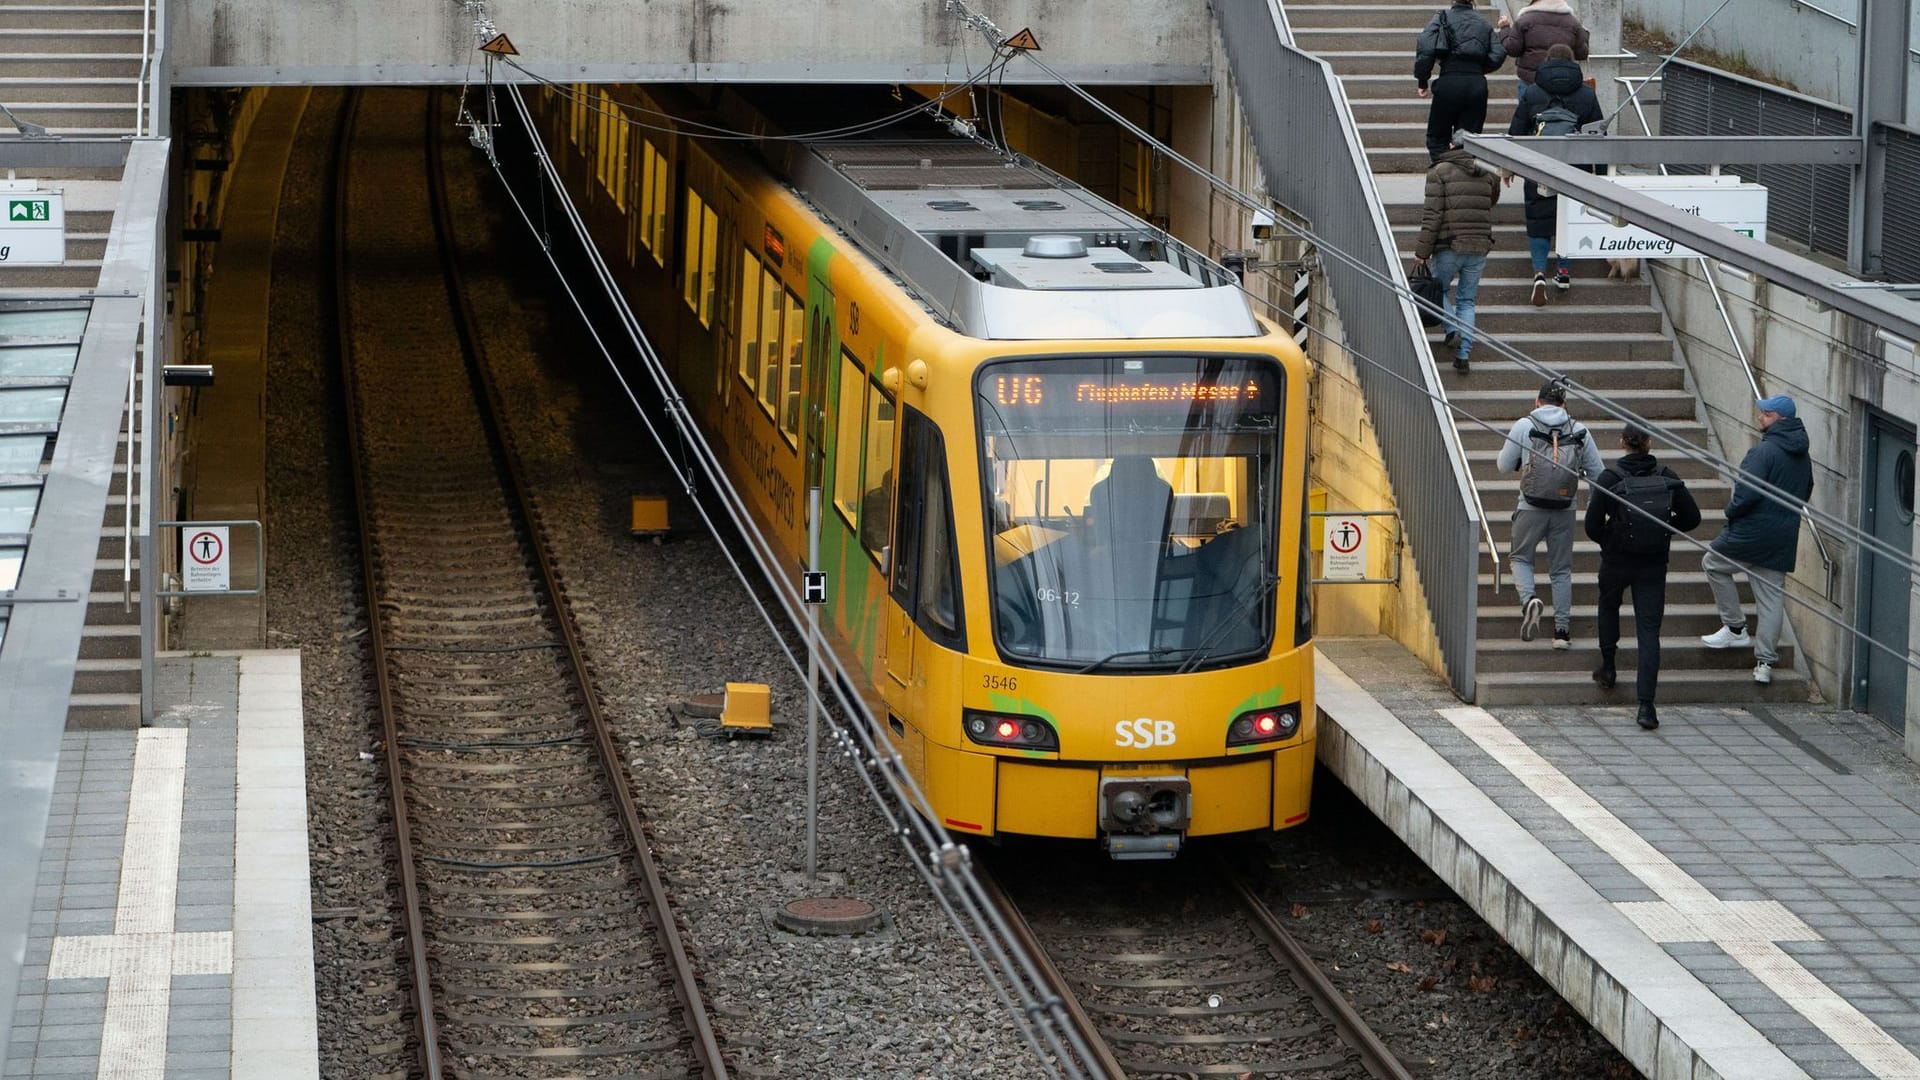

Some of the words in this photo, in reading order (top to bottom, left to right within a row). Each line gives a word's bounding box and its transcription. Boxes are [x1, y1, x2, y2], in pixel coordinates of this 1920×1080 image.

[1680, 205, 1700, 217] xit
[1599, 236, 1675, 254] Laubeweg
[996, 376, 1043, 405] U6
[805, 576, 825, 600] H
[1037, 587, 1080, 606] 06-12
[982, 674, 1017, 691] 3546
[1115, 718, 1177, 749] SSB
